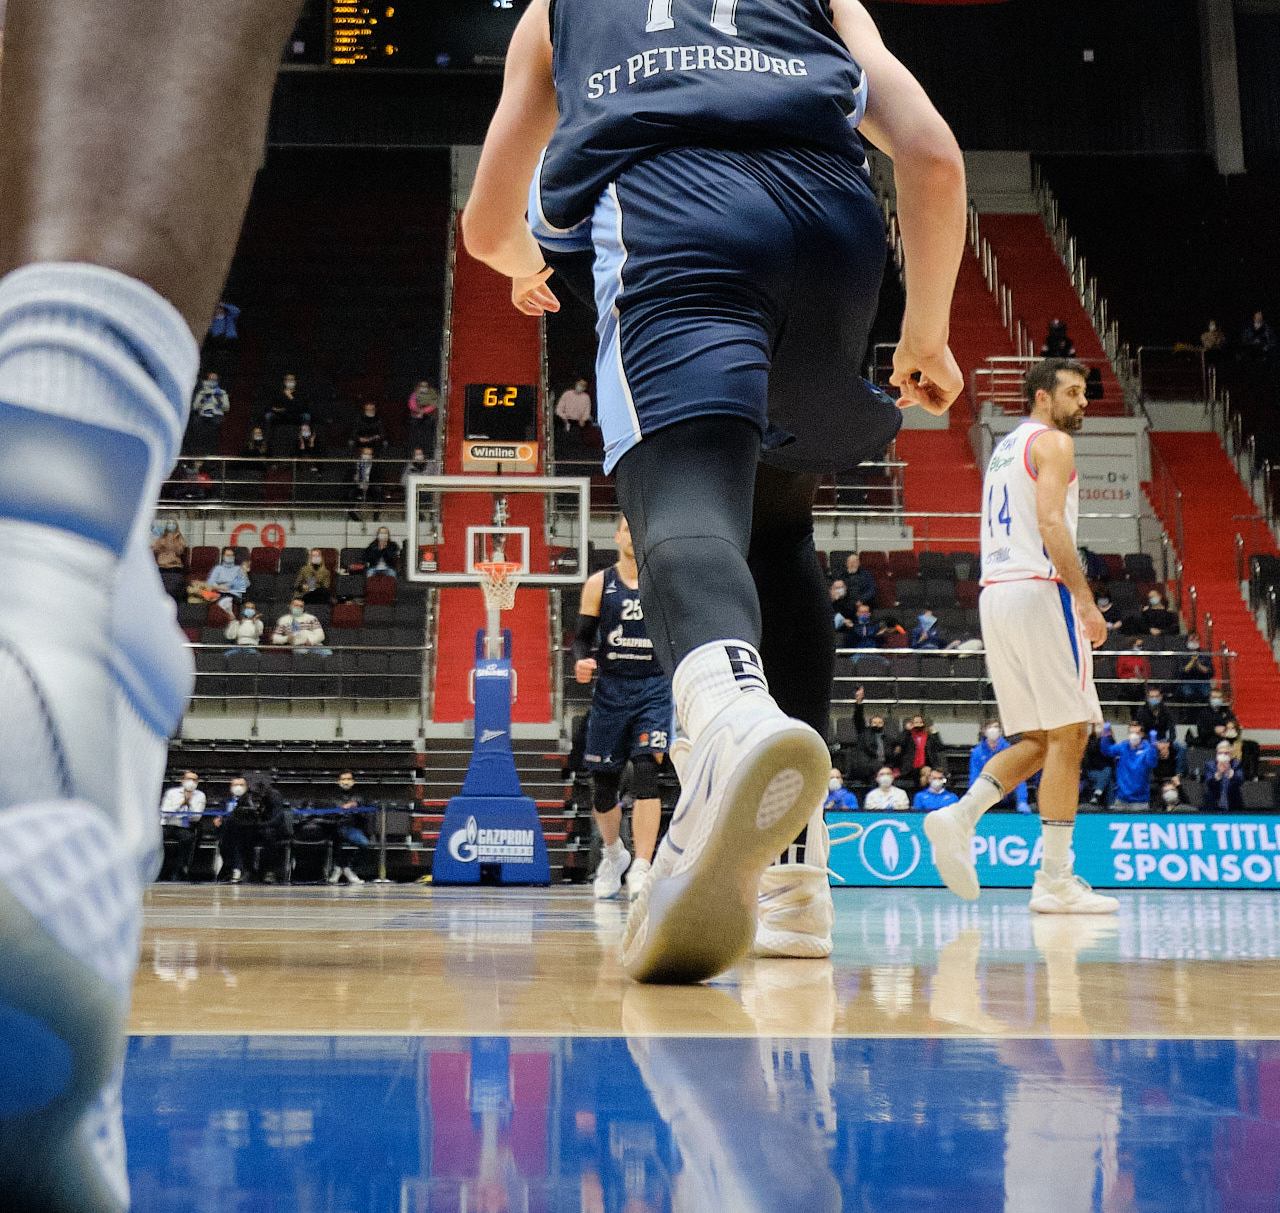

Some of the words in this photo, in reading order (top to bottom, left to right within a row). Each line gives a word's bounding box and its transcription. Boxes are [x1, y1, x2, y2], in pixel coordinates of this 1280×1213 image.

[587, 65, 621, 100] ST
[627, 45, 808, 85] PETERSBURG
[483, 387, 518, 407] 6.2
[473, 447, 515, 458] Winline
[988, 483, 1012, 538] 14
[621, 598, 644, 621] 25
[650, 730, 668, 749] 25
[477, 828, 535, 846] GAZPROM
[1109, 822, 1206, 851] ZENIT
